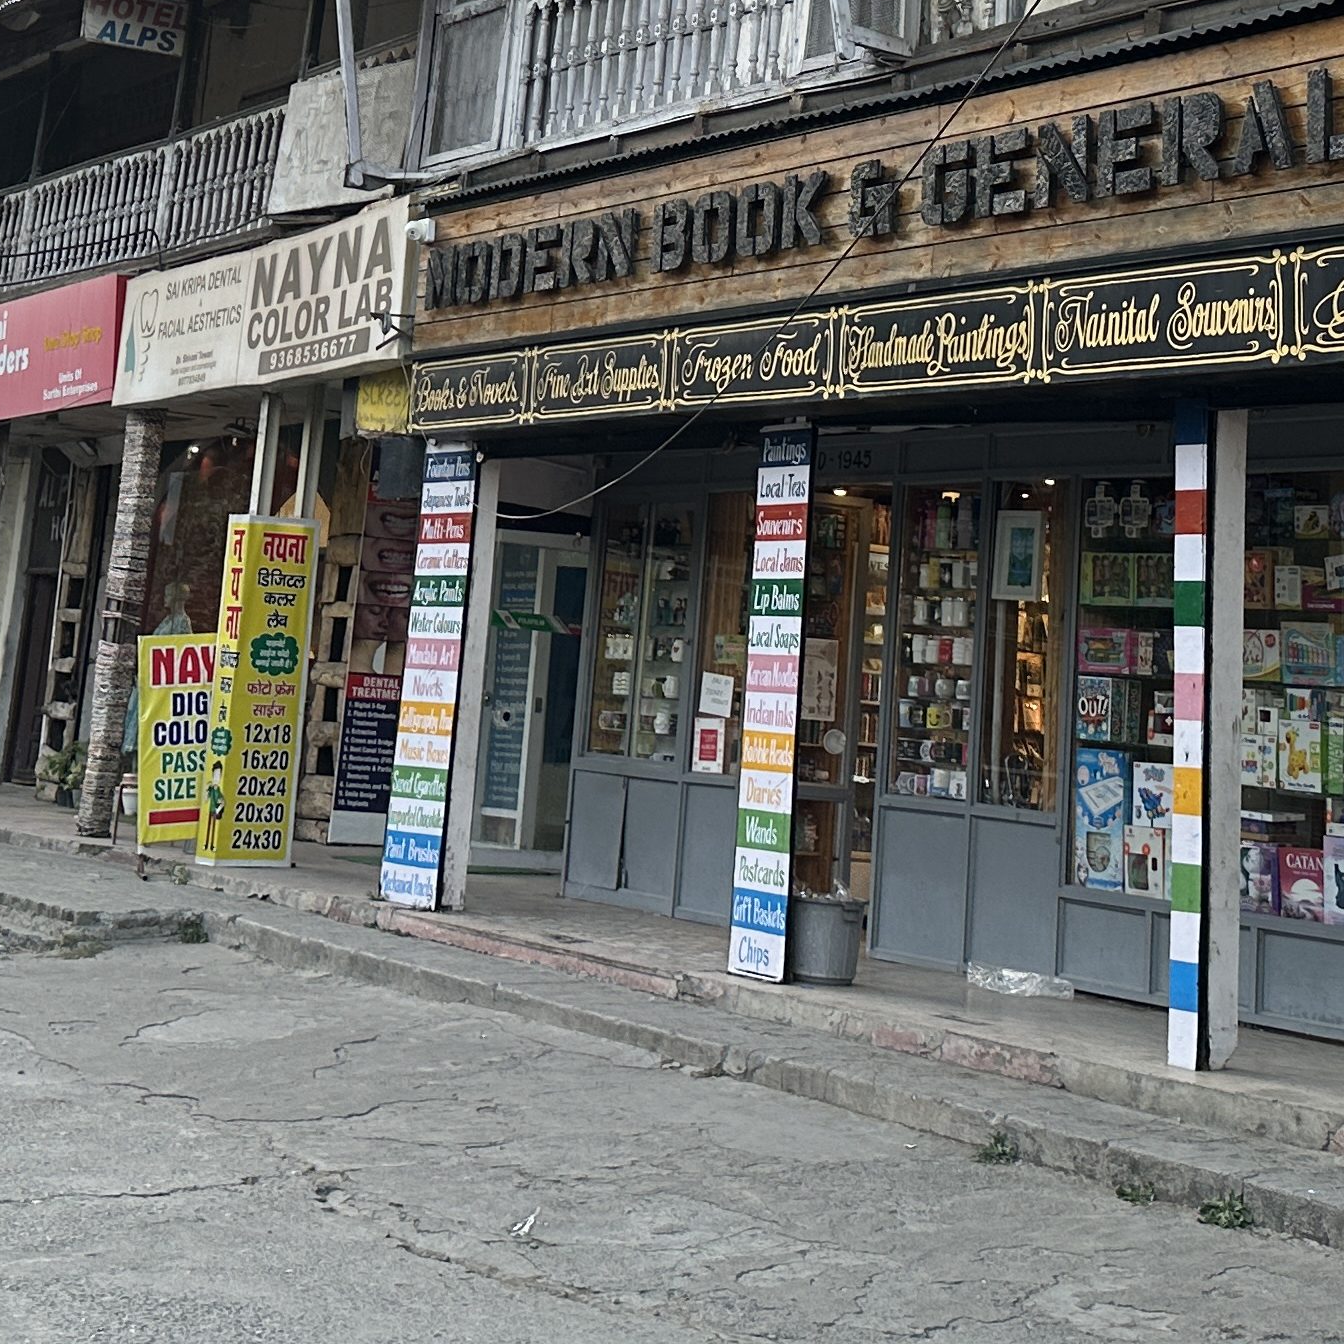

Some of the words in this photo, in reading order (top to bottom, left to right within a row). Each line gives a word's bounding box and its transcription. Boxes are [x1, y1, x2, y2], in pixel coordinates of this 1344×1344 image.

[96, 20, 177, 52] ALPS
[425, 208, 641, 312] MODERN
[652, 170, 830, 274] BOOK
[251, 217, 393, 310] NAYNA
[166, 281, 180, 301] SAI
[181, 274, 206, 296] KRIPA
[208, 266, 242, 291] DENTAL
[158, 317, 185, 340] FACIAL
[187, 304, 242, 334] AESTHETICS
[247, 295, 331, 350] COLOR
[338, 277, 394, 329] LAB
[1056, 293, 1160, 354] Nainital
[1167, 282, 1278, 350] Souvenirs
[848, 320, 934, 378] Handmade
[926, 312, 1031, 376] Paintings
[682, 337, 754, 393] Frozen
[760, 330, 822, 382] Food
[416, 373, 454, 413] Books
[455, 376, 468, 409] &
[469, 367, 520, 407] Novels
[537, 362, 570, 402] Fine
[570, 355, 599, 404] Art
[600, 351, 660, 402] Supplies
[763, 437, 807, 465] Paintings
[838, 450, 872, 470] 1945
[760, 475, 785, 498] Local
[787, 473, 807, 498] Teas
[756, 511, 803, 535] Souvenirs
[263, 532, 308, 565] नयना
[755, 548, 779, 572] Local
[780, 548, 804, 572] Jams
[257, 568, 306, 589] डिजिटल
[438, 581, 464, 602] Paints
[264, 592, 297, 608] कलर
[754, 586, 769, 615] Lip
[771, 585, 800, 611] Balms
[411, 612, 434, 635] Water
[433, 612, 461, 635] Colours
[750, 621, 773, 649] Local
[774, 620, 799, 654] Soaps
[439, 643, 455, 665] Art
[247, 680, 272, 696] फोटो
[273, 681, 296, 698] फ्रेम
[363, 677, 400, 689] DENTAL
[253, 701, 285, 718] साईज
[746, 699, 773, 726] Indian
[774, 700, 794, 729] Inks
[1079, 695, 1109, 716] OUT!
[244, 723, 291, 745] 12x18
[241, 750, 289, 771] 16x20
[155, 778, 196, 801] SIZE
[237, 776, 286, 797] 20x24
[746, 777, 782, 807] Diaries
[234, 803, 284, 824] 20x30
[231, 829, 282, 851] 24x30
[745, 816, 777, 845] Wands
[386, 834, 406, 859] Paint
[408, 837, 439, 864] Brushes
[1285, 852, 1324, 871] CATAN
[738, 856, 784, 887] Postcards
[733, 897, 751, 923] Gift
[753, 900, 785, 931] Baskets
[739, 936, 770, 967] Chips
